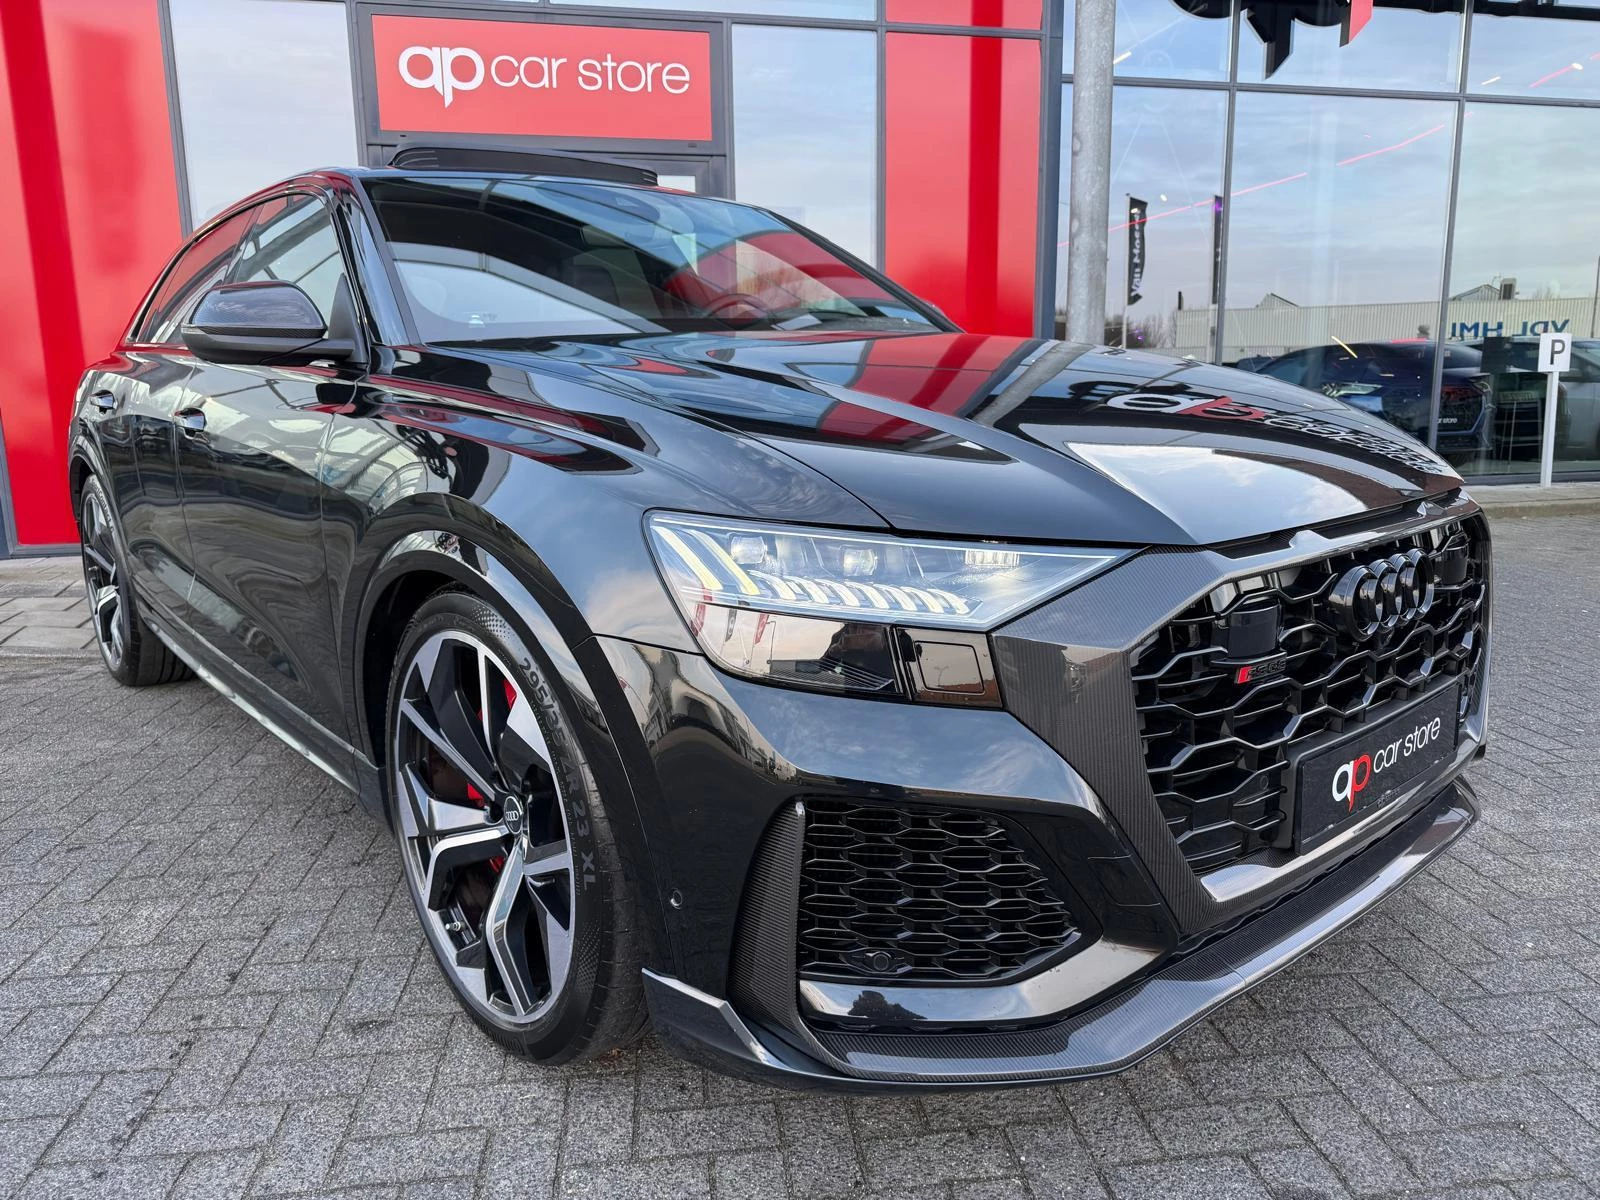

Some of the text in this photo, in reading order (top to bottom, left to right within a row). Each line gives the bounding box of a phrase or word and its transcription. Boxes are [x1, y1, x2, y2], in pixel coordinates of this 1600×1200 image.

[398, 46, 691, 108] ap car store
[1549, 338, 1566, 366] P
[519, 657, 567, 747] 295/35
[558, 752, 580, 794] ZR
[572, 799, 590, 837] 23
[581, 850, 597, 891] XL
[1331, 754, 1372, 813] ap
[1373, 738, 1403, 773] car
[1403, 717, 1441, 757] store
